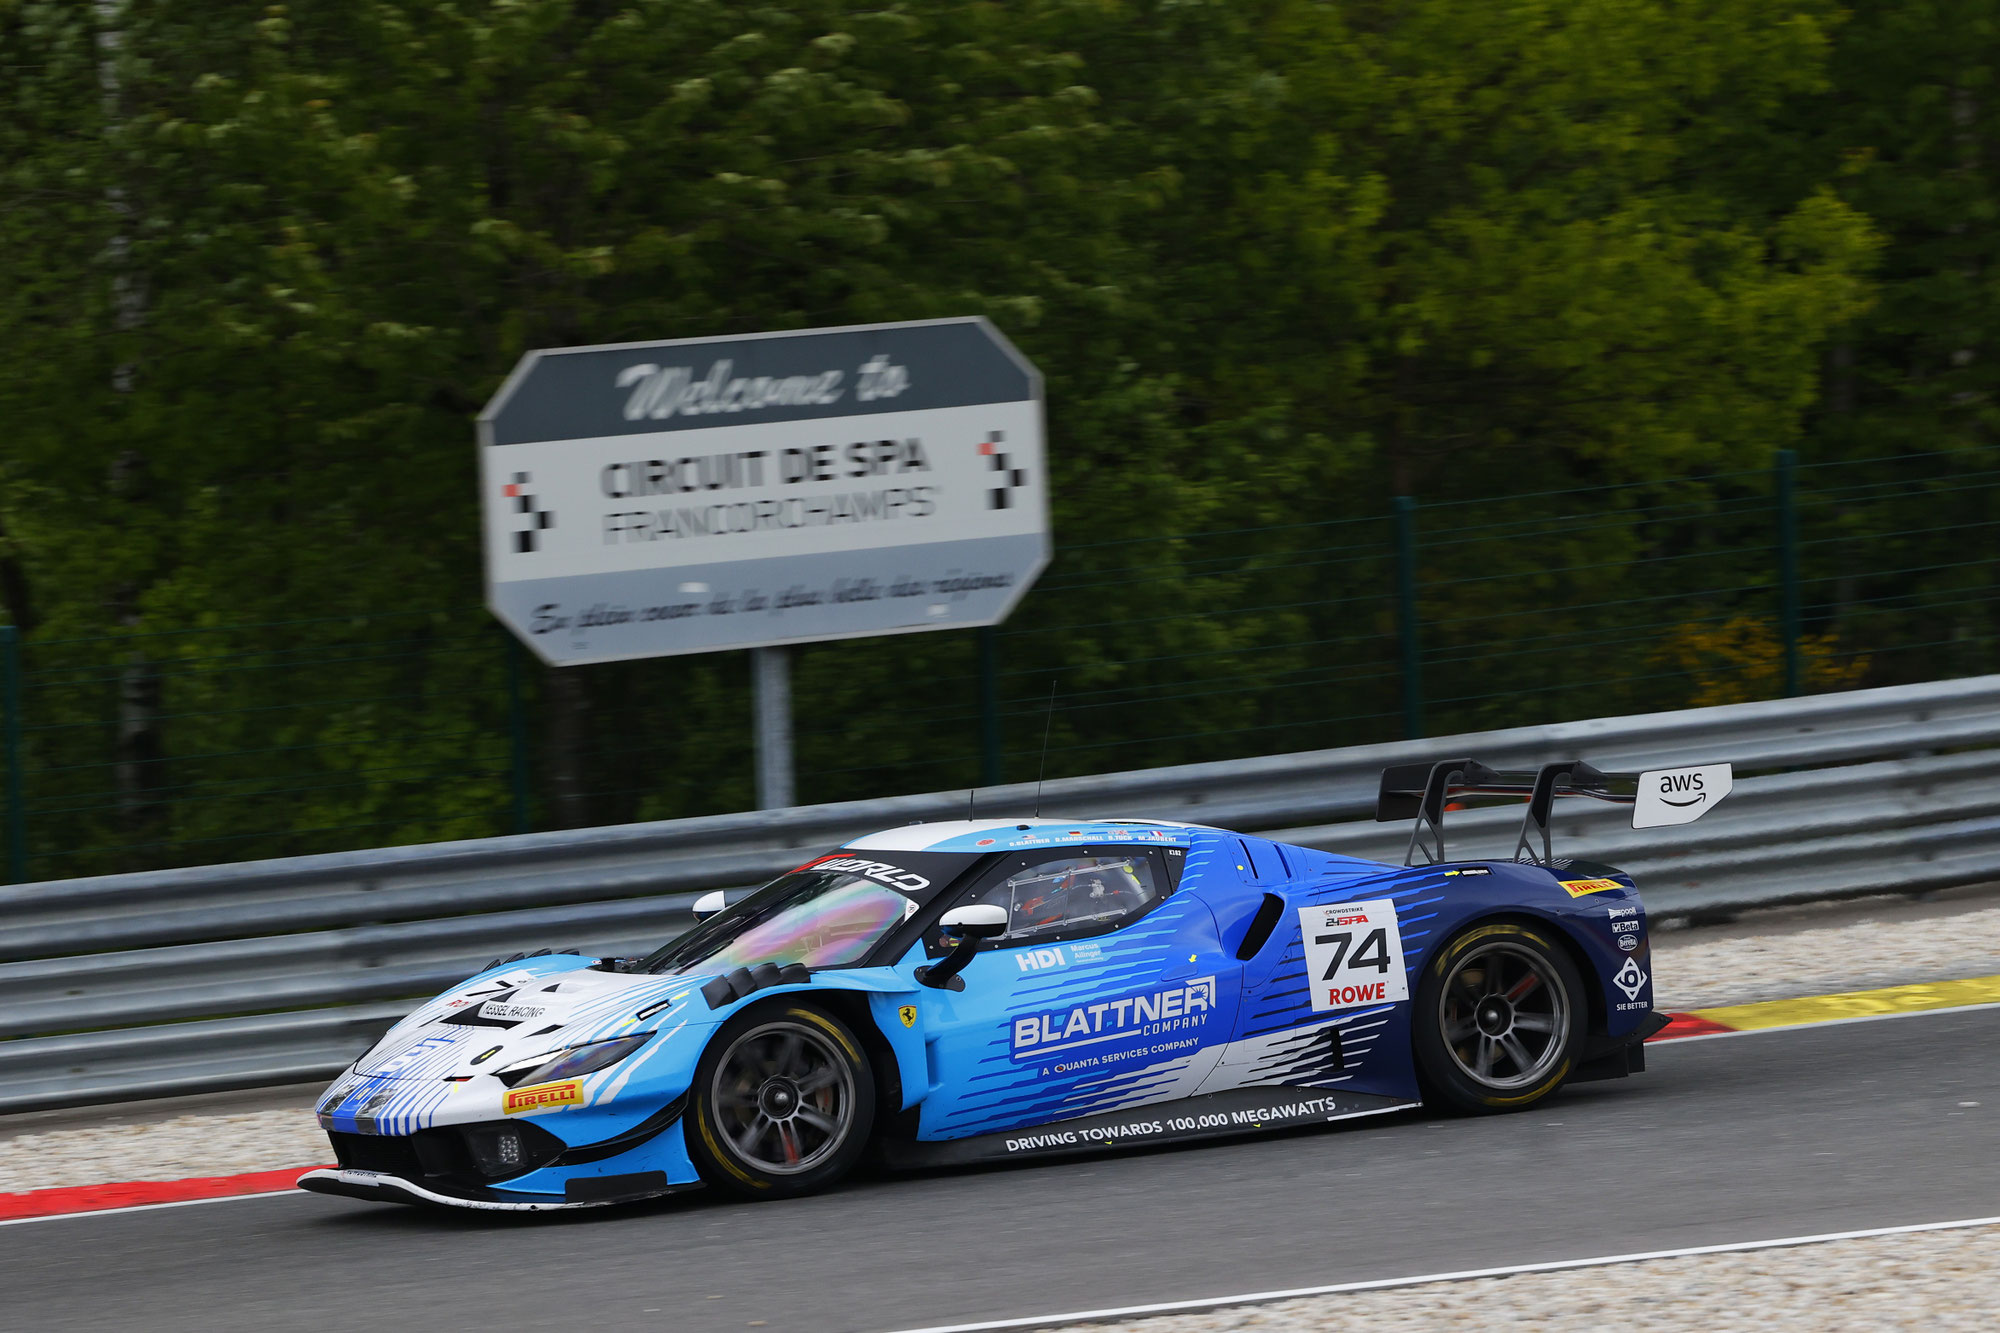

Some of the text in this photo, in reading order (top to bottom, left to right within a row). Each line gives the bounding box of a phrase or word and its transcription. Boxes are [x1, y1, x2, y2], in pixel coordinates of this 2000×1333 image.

[616, 354, 911, 420] Welcome to
[601, 437, 933, 499] CIRCUIT DE SPA
[603, 486, 937, 546] FRANCORCHAMPS
[1660, 773, 1704, 793] aws
[810, 858, 930, 891] WORLD
[1567, 880, 1615, 893] PIRELLI
[1620, 923, 1638, 932] Beta
[1015, 948, 1066, 972] HDI
[1314, 927, 1391, 981] 74
[1329, 982, 1386, 1005] ROWE
[483, 1003, 546, 1018] KESSEL RACING
[1015, 982, 1209, 1048] BLATTNER
[1616, 1001, 1649, 1011] SIE BETTER
[1143, 1013, 1208, 1037] COMPANY
[1042, 1037, 1200, 1076] A QUANTA SERVICES COMPANY
[509, 1084, 576, 1108] PIRELLI
[1005, 1096, 1337, 1152] DRIVING TOWARDS 100,000 MEGAWATTS
